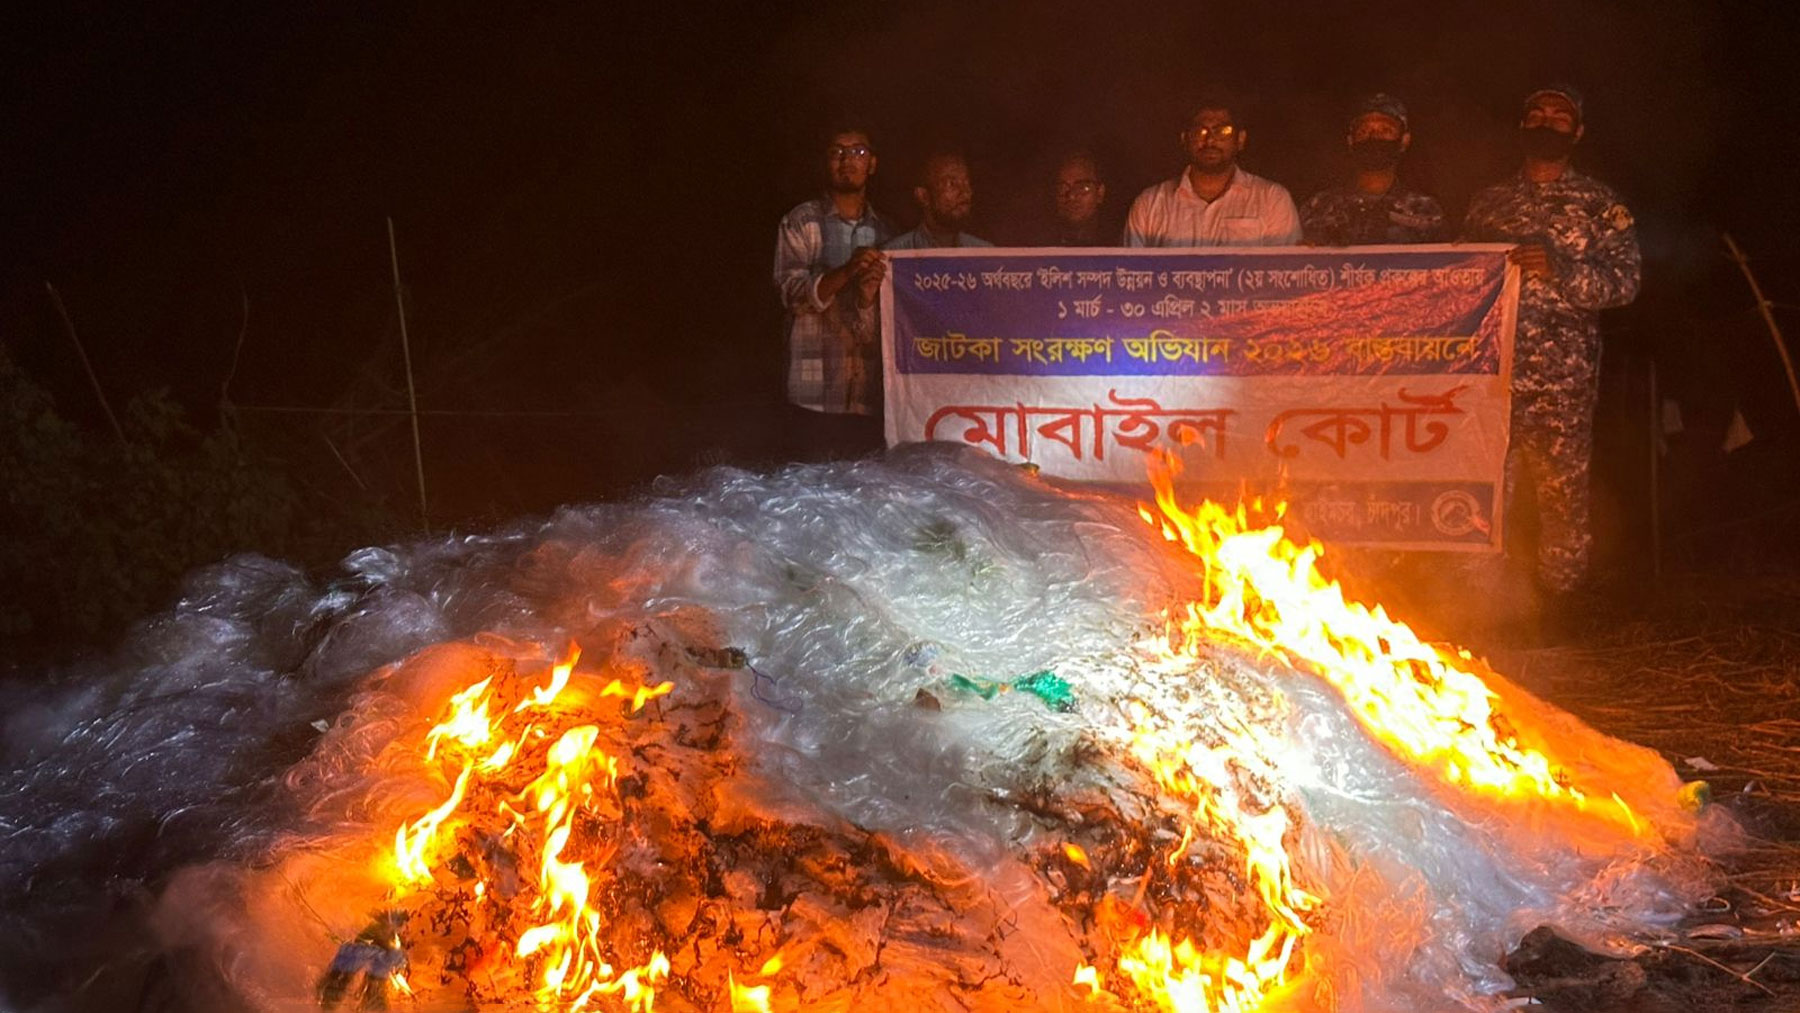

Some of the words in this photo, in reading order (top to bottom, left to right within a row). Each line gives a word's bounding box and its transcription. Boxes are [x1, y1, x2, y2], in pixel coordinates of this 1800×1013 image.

[914, 272, 976, 291] ২০২৫-২৬
[981, 266, 1033, 291] অর্থবছরে
[1077, 270, 1113, 290] সম্পদ
[1116, 266, 1153, 291] উন্নয়ন
[1157, 272, 1168, 288] ও
[1237, 269, 1264, 292] (২য়
[1267, 264, 1335, 291] সংশোধিত)
[1340, 263, 1376, 287] শীর্ষক
[1058, 301, 1068, 319] ১
[1074, 294, 1103, 318] মার্চ
[1121, 302, 1146, 317] ৩০
[1151, 294, 1195, 319] এপ্রিল
[1200, 302, 1214, 320] ২
[1217, 300, 1248, 318] মাস
[914, 330, 1004, 363] জাটকা
[1009, 337, 1114, 366] সংরক্ষণ
[1122, 329, 1232, 364] অভিযান
[923, 388, 1237, 460] মোবাইল
[1267, 385, 1470, 460] কোর্ট
